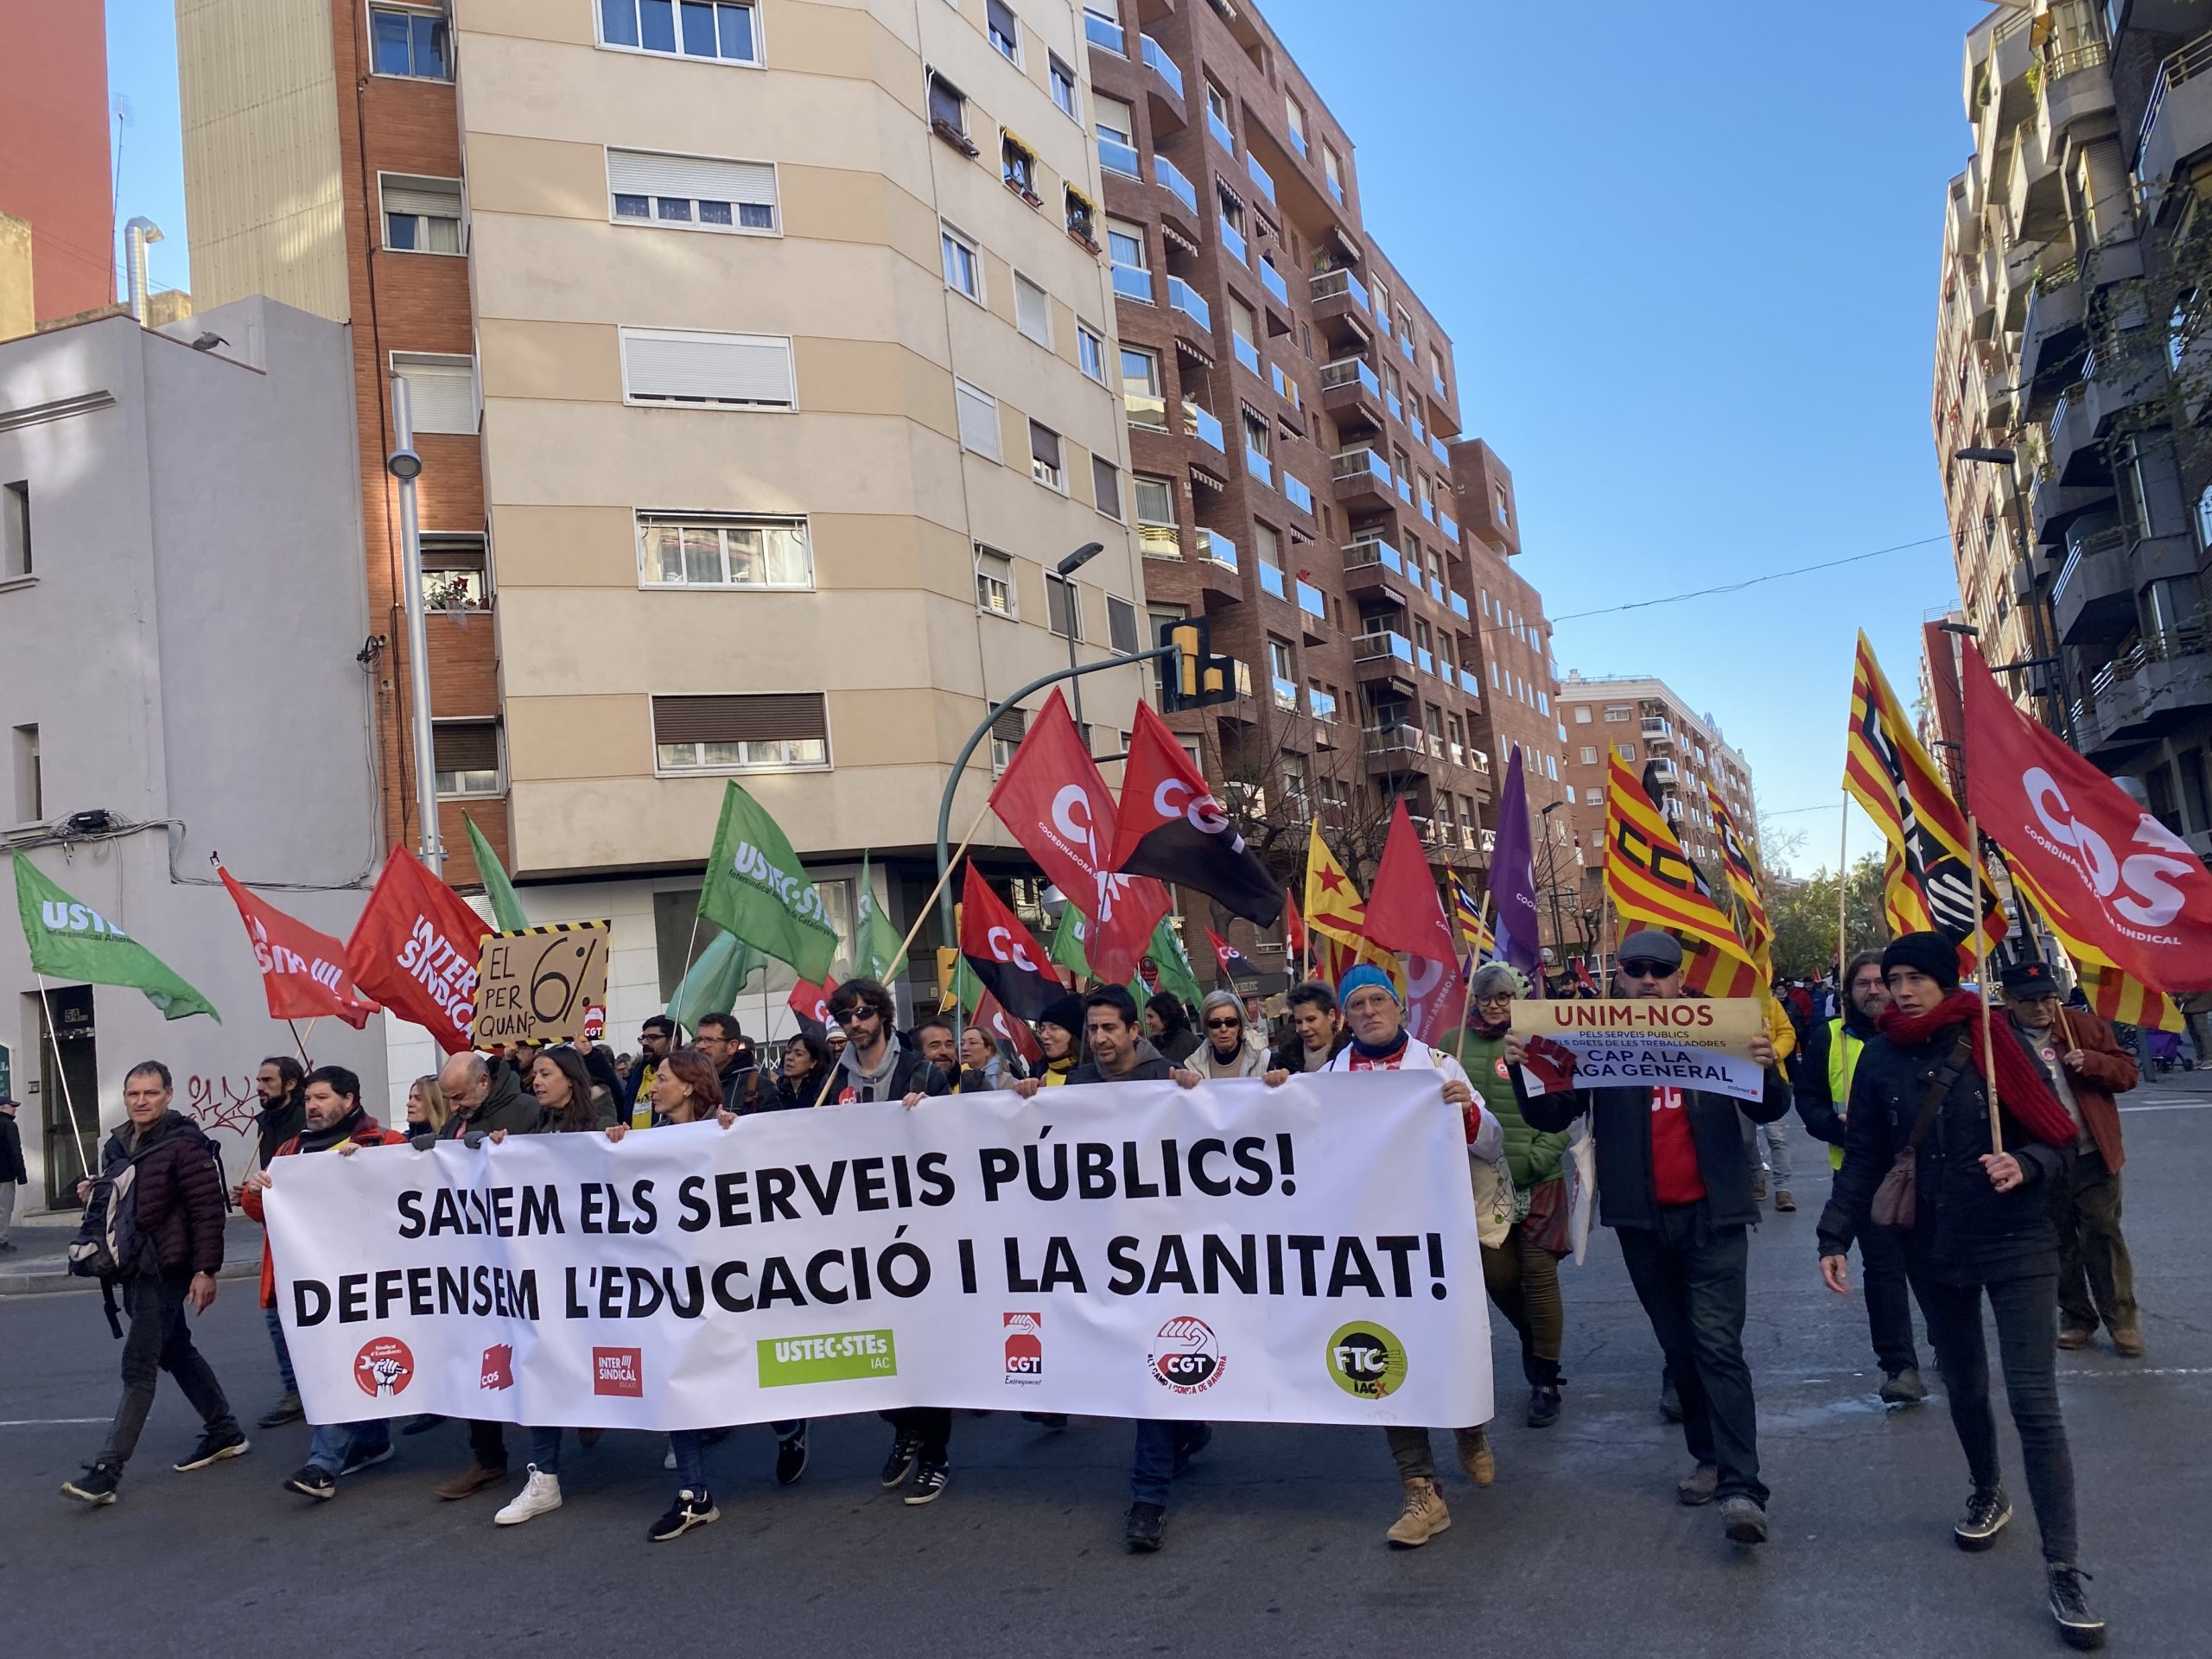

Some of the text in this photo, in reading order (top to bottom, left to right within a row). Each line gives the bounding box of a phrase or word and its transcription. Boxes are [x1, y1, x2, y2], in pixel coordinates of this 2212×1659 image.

[1038, 822, 1094, 877] COORDINADORA
[2023, 767, 2196, 927] COS
[2116, 924, 2182, 945] SINDICAL
[412, 914, 477, 998] INTER
[490, 946, 515, 980] EL
[531, 937, 598, 1024] 6%
[485, 984, 523, 1010] PER
[66, 1010, 79, 1021] 54
[479, 1011, 537, 1038] QUAN?
[1554, 1005, 1713, 1027] UNIM-NOS
[584, 1027, 604, 1037] CGT
[1587, 1050, 1692, 1063] CAP A LA
[1621, 1064, 1733, 1083] GENERAL
[398, 1125, 1297, 1238] SALVEM ELS SERVEIS PÚBLICS!
[293, 1224, 1447, 1327] DEFENSEM L'EDUCACIÓ I LA SANITAT!
[598, 1357, 621, 1369] INTER
[871, 1357, 890, 1369] IAC
[1006, 1356, 1040, 1373] CGT
[1166, 1357, 1206, 1373] CGT
[1333, 1346, 1385, 1372] FTC
[481, 1370, 499, 1385] COS
[599, 1368, 637, 1382] SINDICAL
[1152, 1368, 1168, 1386] CAMP
[1173, 1384, 1197, 1395] CONCA
[1198, 1382, 1208, 1393] DE
